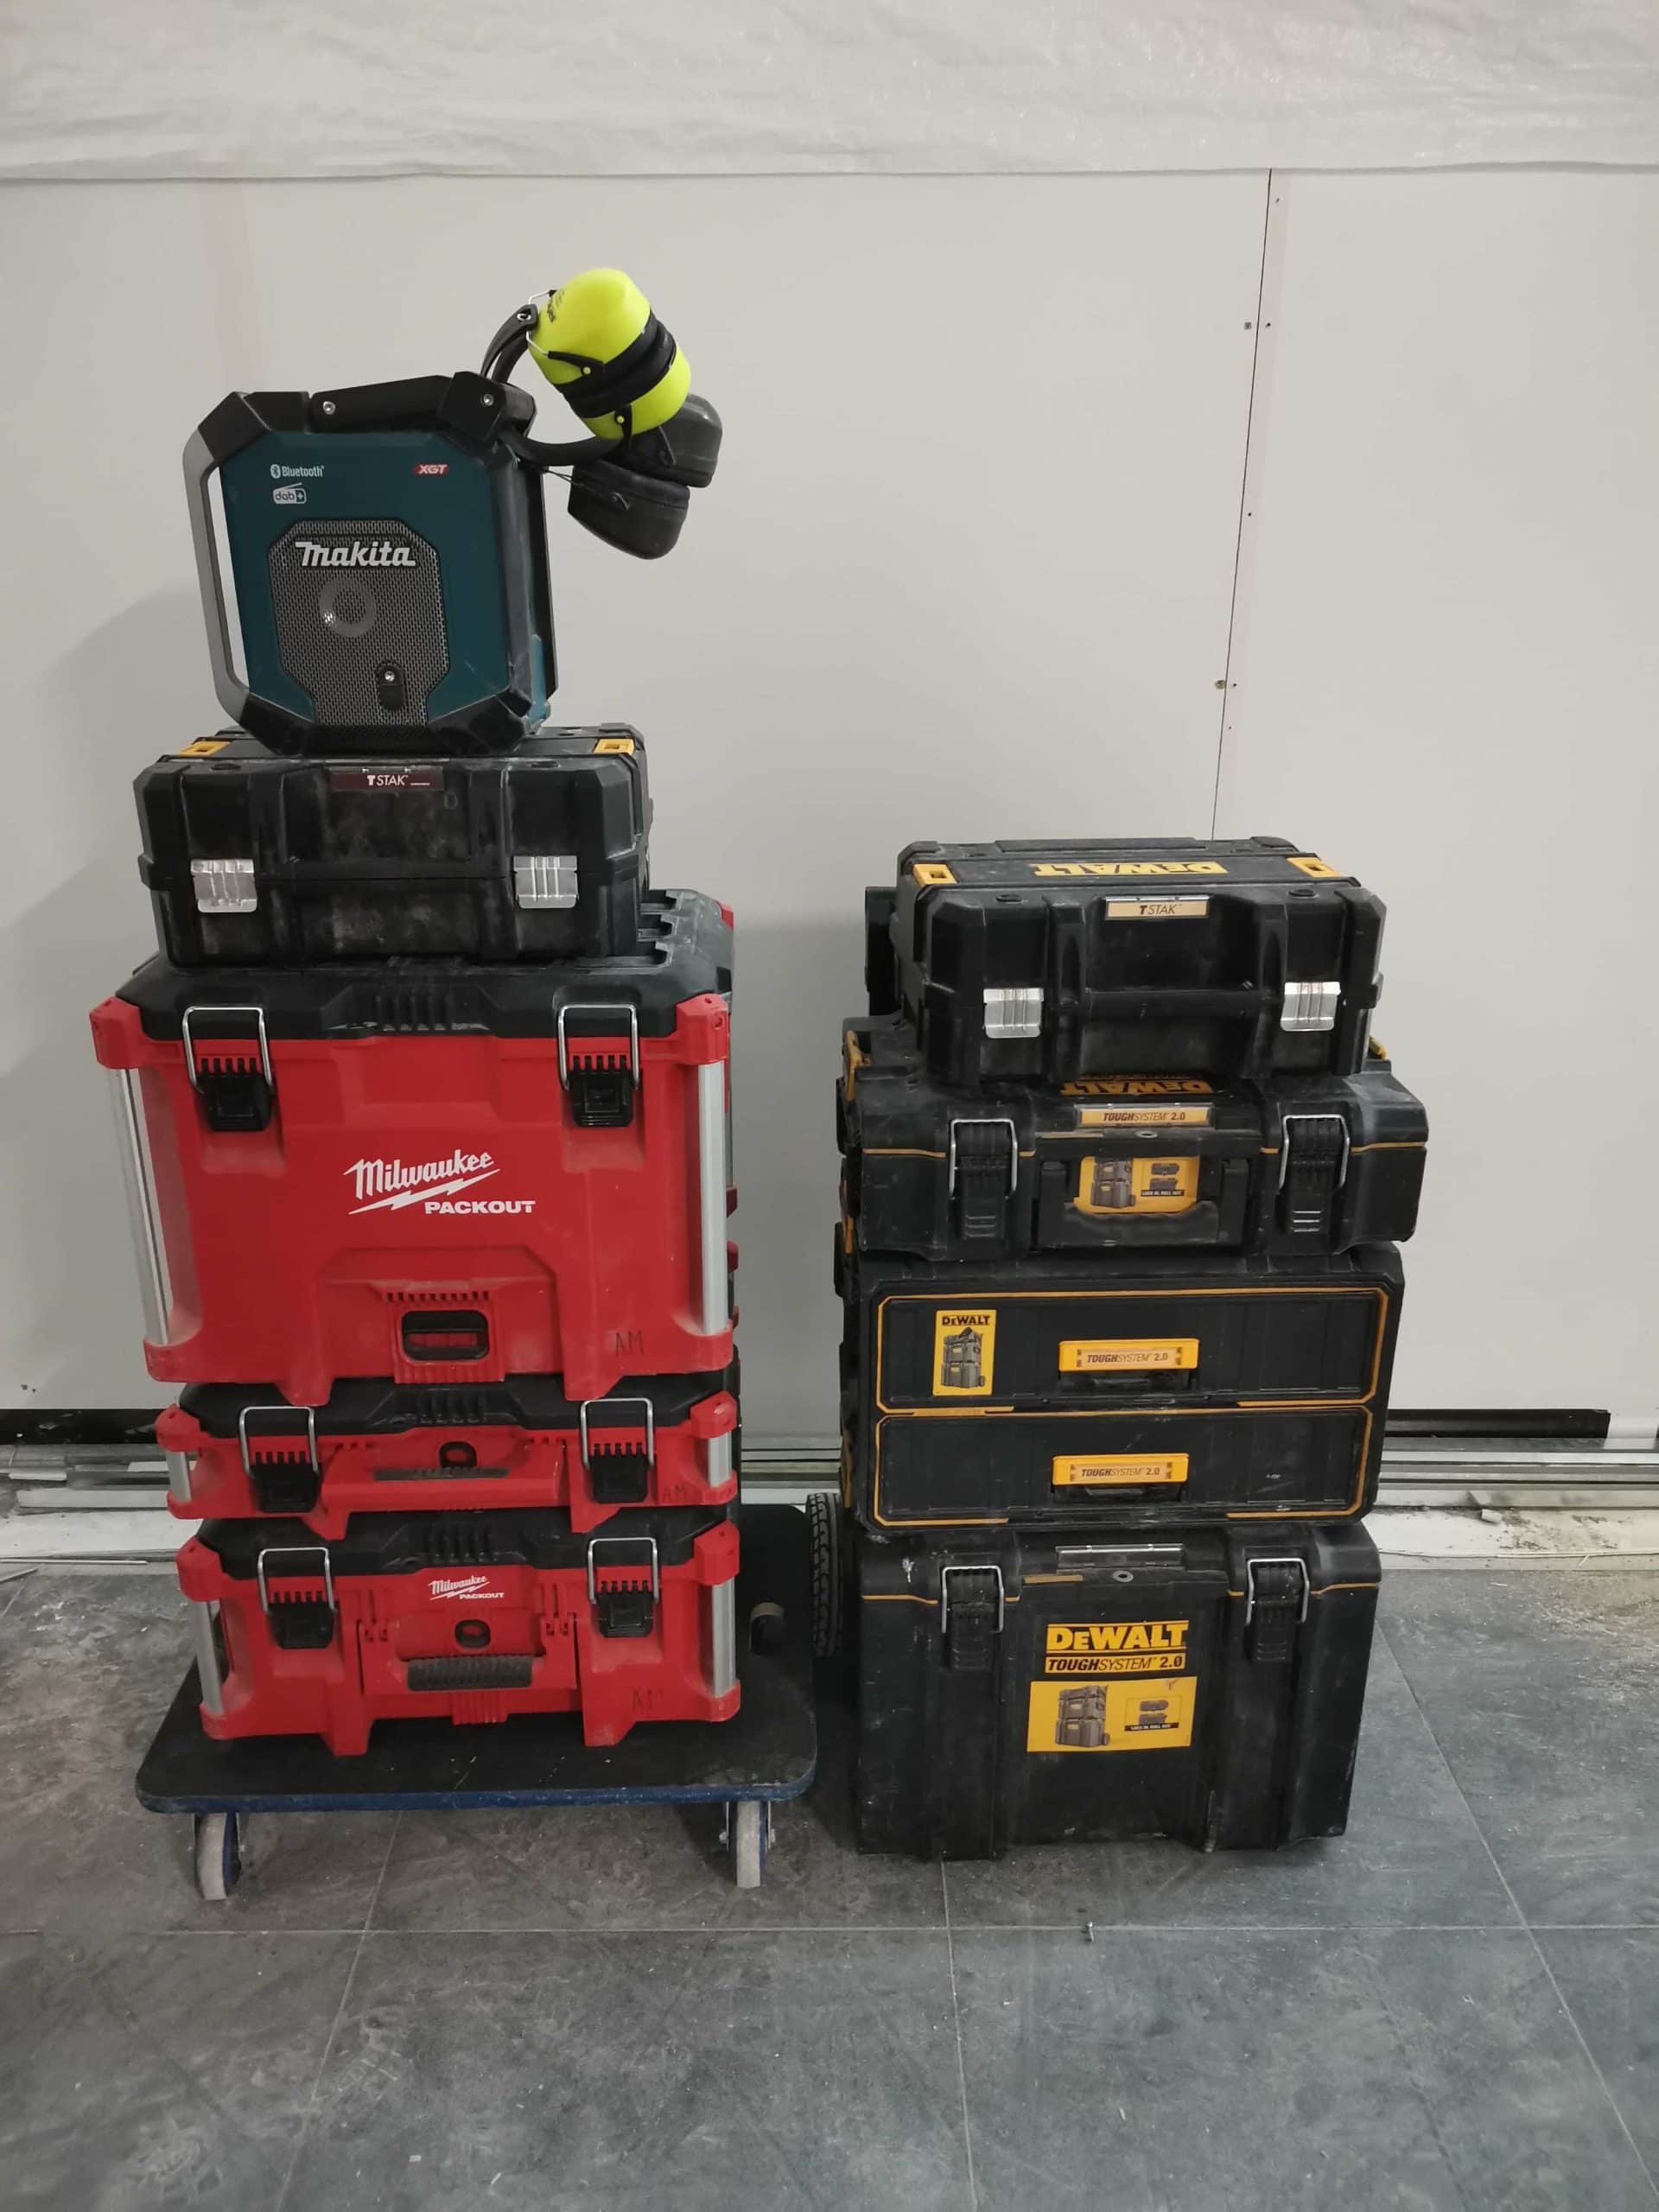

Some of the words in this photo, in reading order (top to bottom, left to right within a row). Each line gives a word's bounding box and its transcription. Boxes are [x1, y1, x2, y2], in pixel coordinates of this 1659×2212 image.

[282, 466, 323, 477] Bluetooth
[418, 464, 448, 474] XGT
[1103, 1113, 1167, 1122] TOUGHSYSTEM
[1171, 1112, 1185, 1122] 2.0
[343, 1149, 494, 1200] Milwaukee
[424, 1200, 536, 1214] PACKOUT
[942, 1315, 991, 1325] DEWALT
[1087, 1354, 1150, 1363] TOUGHSYSTEM
[1154, 1353, 1168, 1362] 2.0
[1146, 1467, 1160, 1476] 2.0
[429, 1575, 488, 1594] Milwaukee
[1046, 1623, 1189, 1650] DEWALT
[1048, 1657, 1152, 1671] TOUGHSYSTEM
[1160, 1656, 1182, 1669] 2.0
